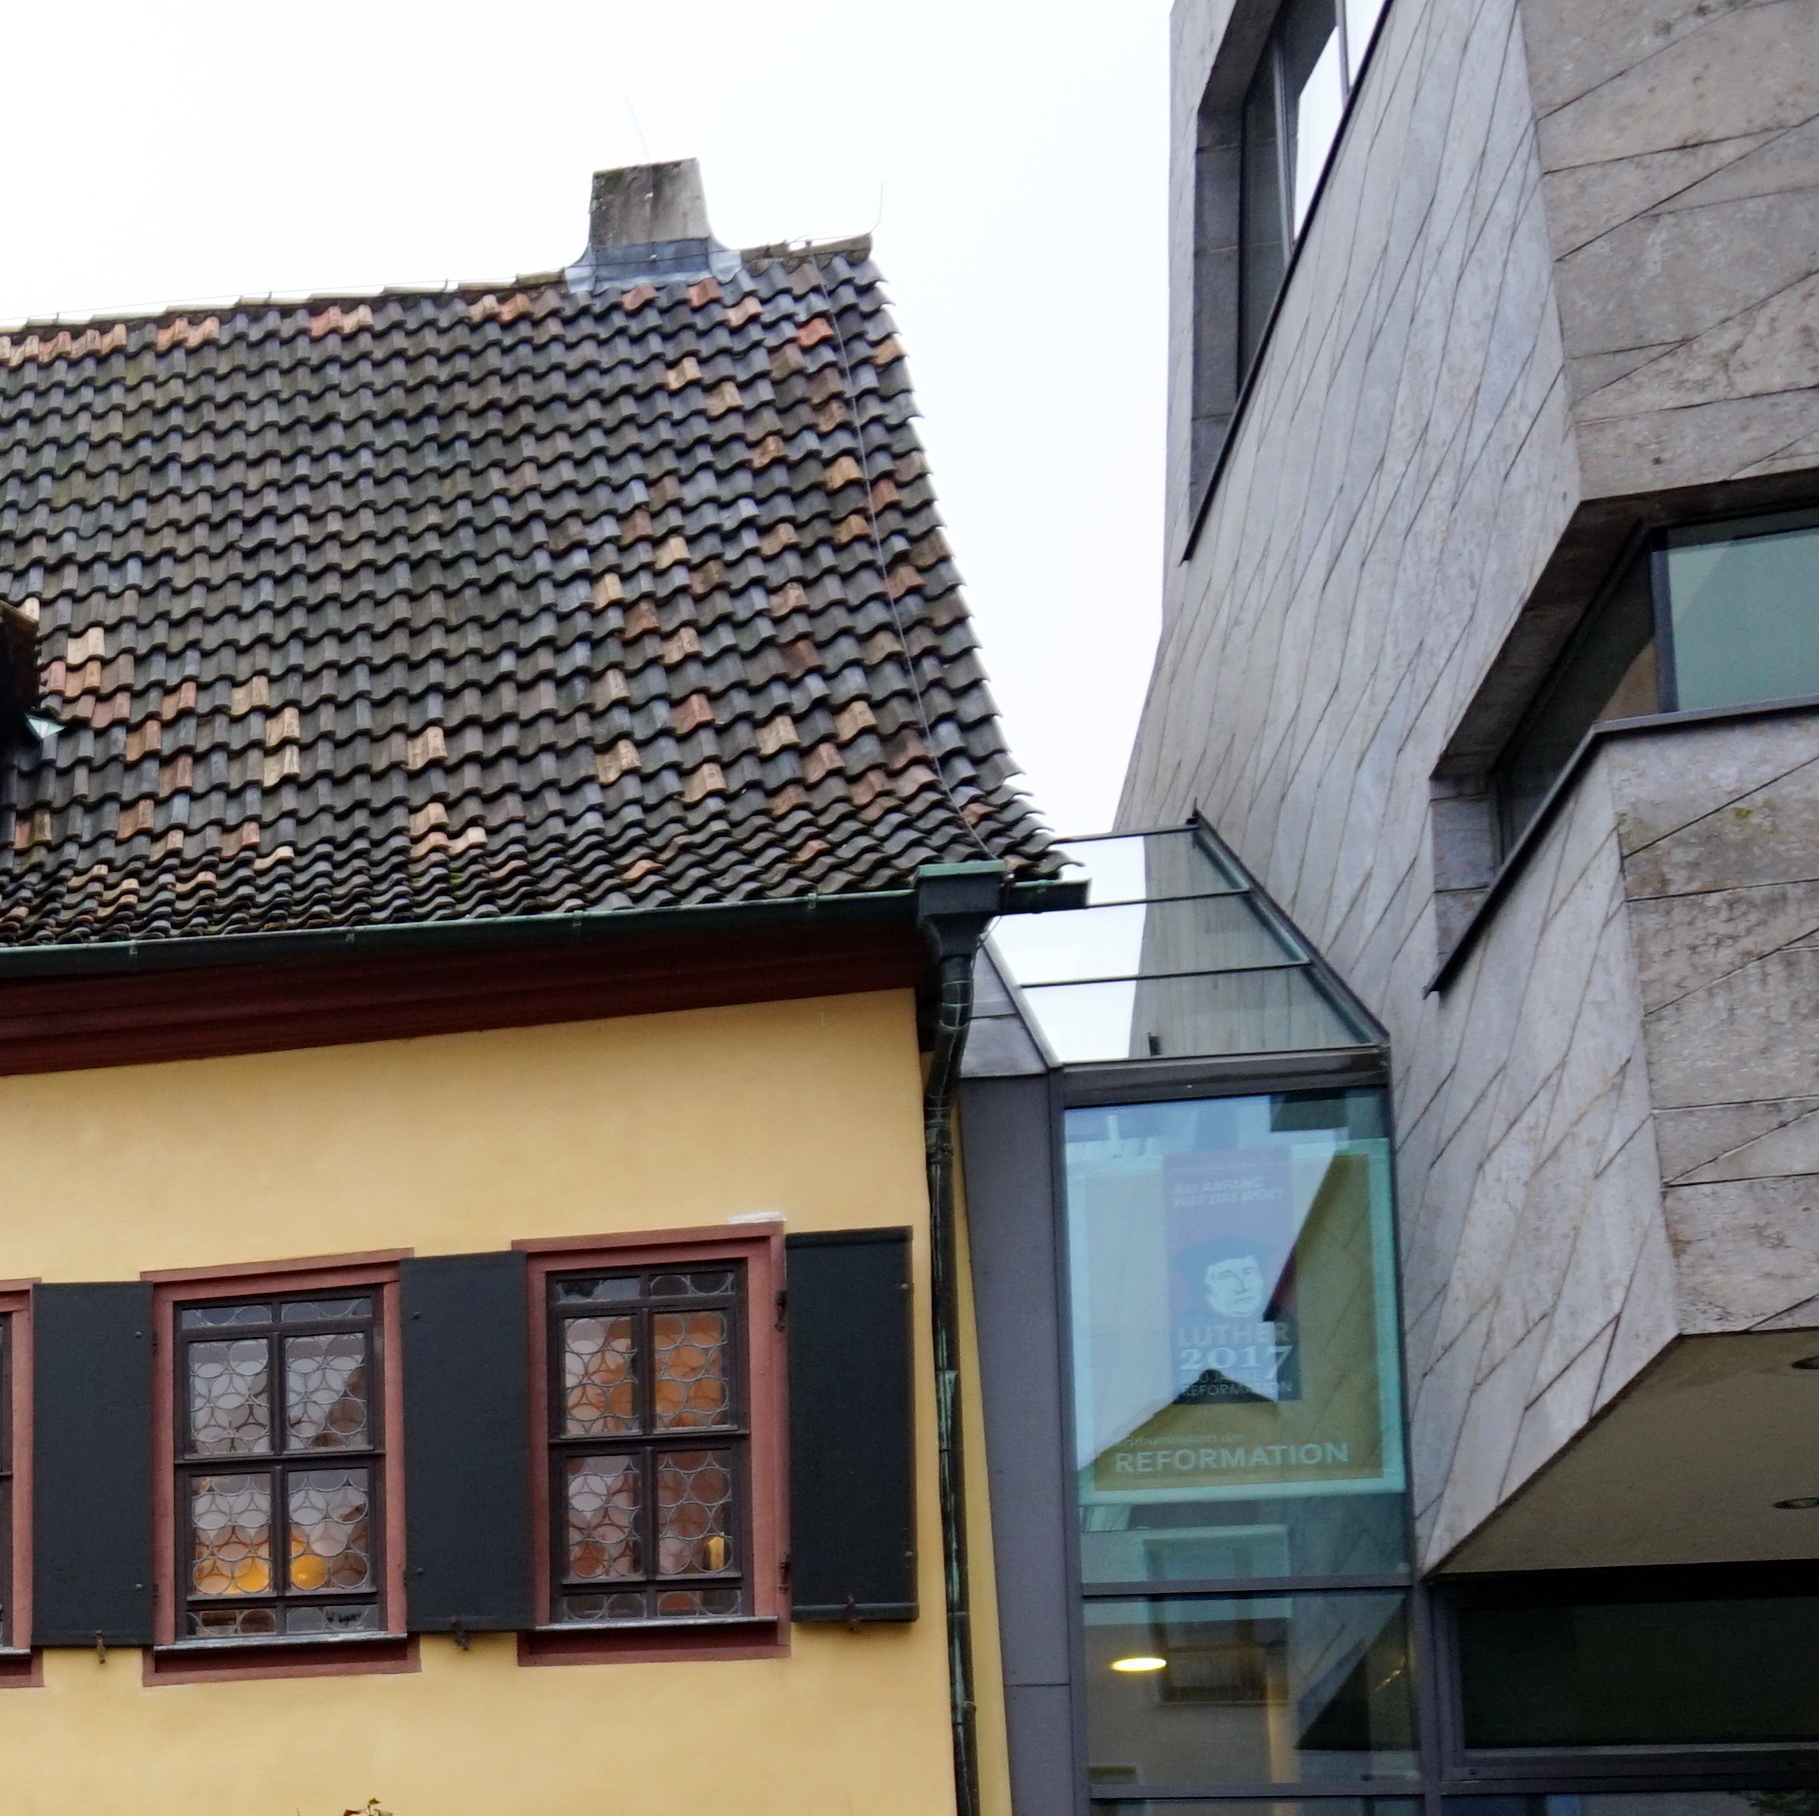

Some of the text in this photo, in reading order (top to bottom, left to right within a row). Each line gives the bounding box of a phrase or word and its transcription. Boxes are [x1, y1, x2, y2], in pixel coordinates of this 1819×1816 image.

[1178, 1322, 1289, 1346] LUTHER
[1179, 1345, 1293, 1381] 2017
[1115, 1442, 1350, 1473] REFORMATION
